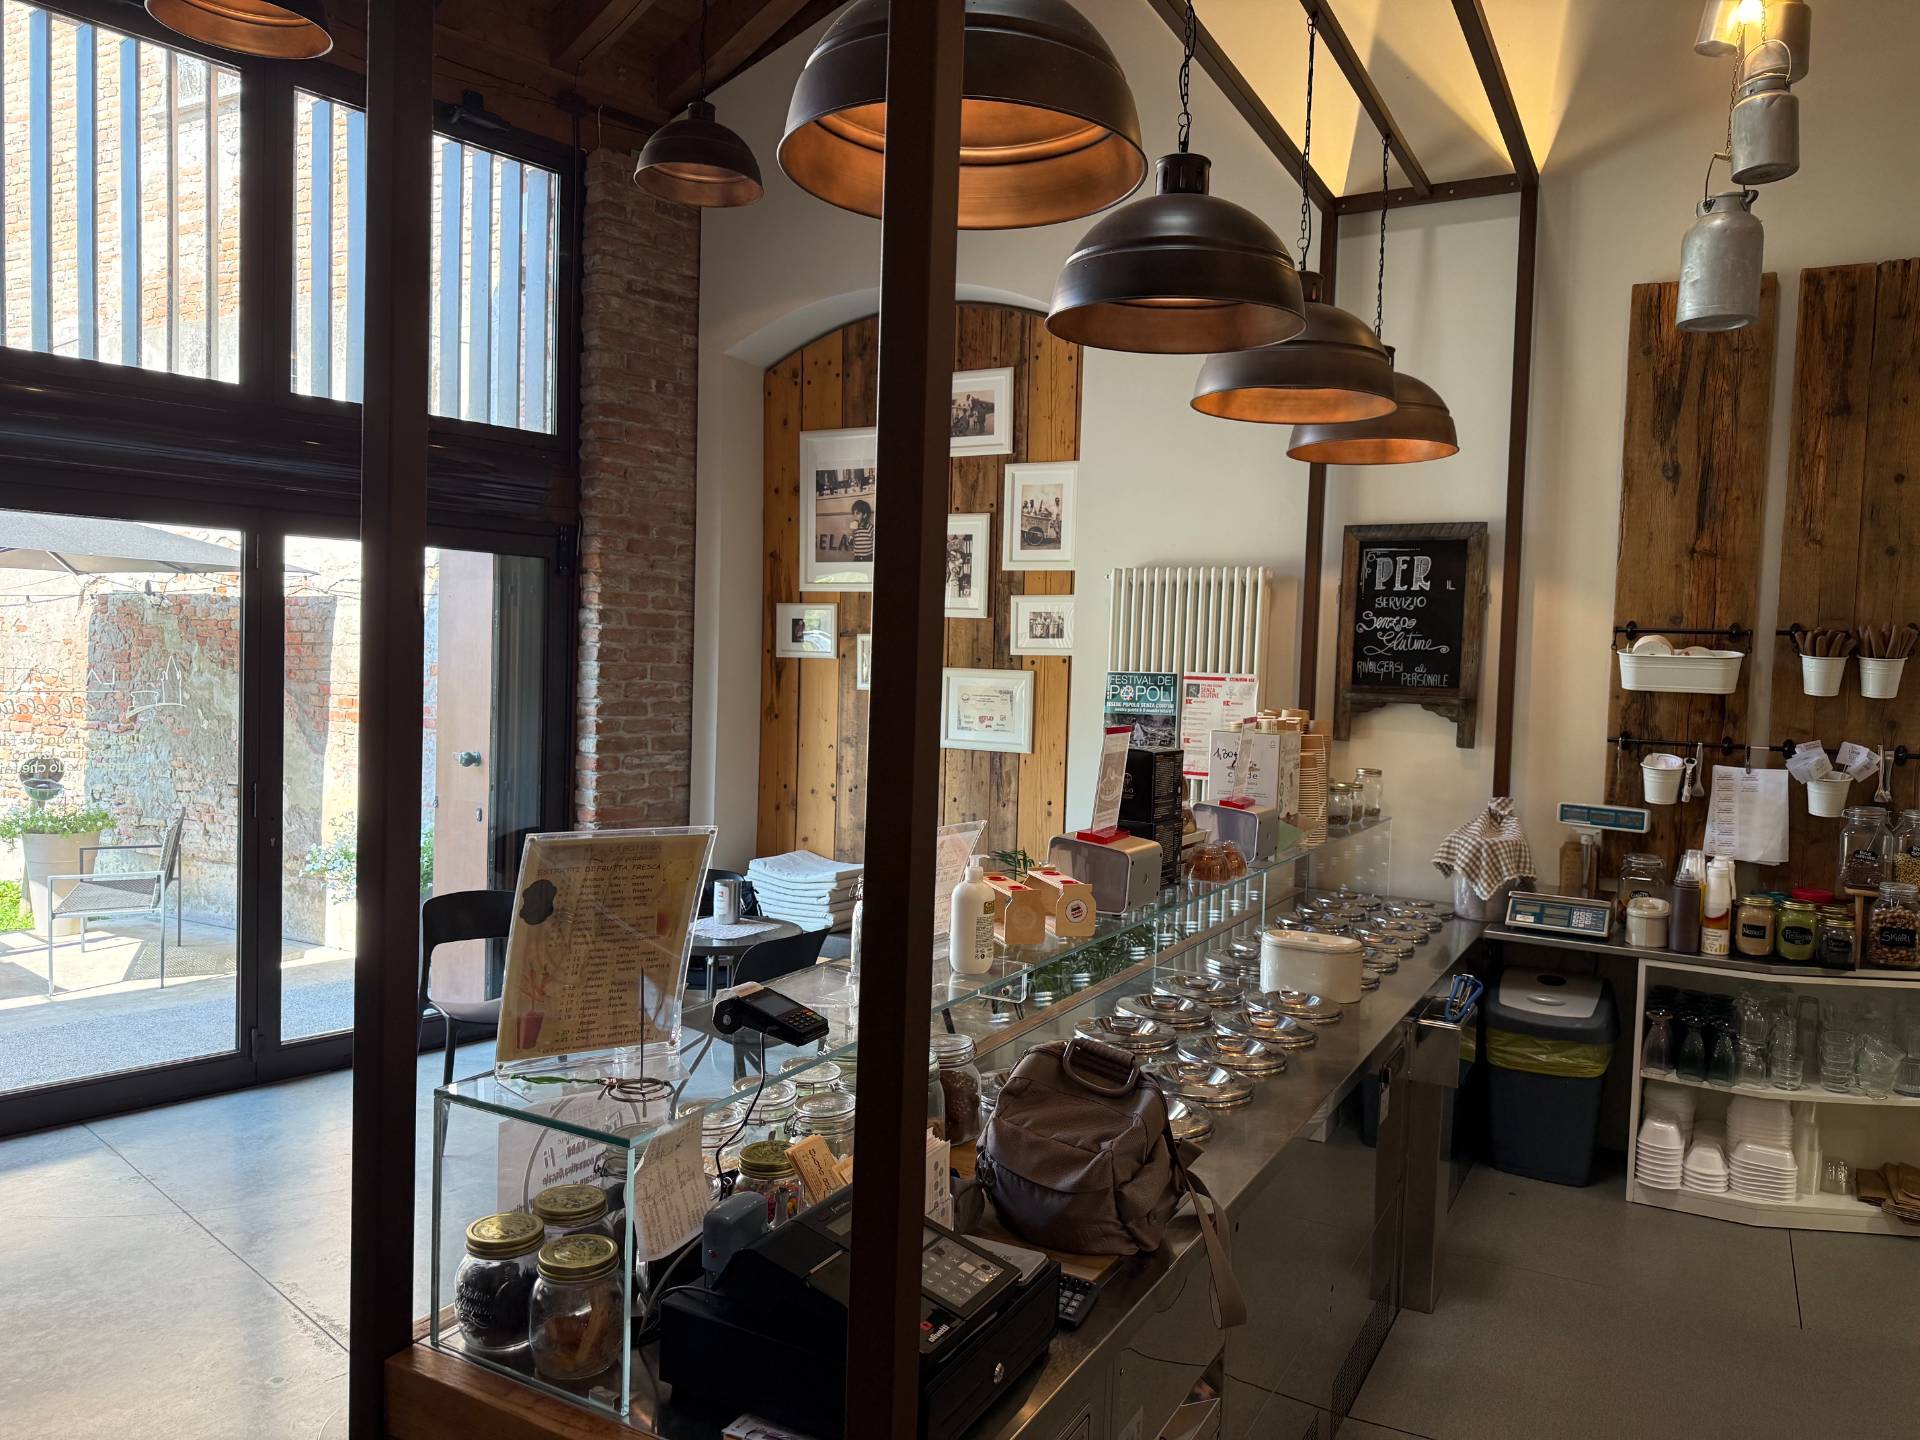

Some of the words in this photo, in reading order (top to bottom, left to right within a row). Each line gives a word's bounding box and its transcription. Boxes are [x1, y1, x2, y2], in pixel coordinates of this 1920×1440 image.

[816, 533, 849, 551] ELA
[1374, 555, 1432, 591] PER
[1446, 580, 1456, 590] IL
[1375, 596, 1427, 611] SERVIZIO
[1356, 610, 1417, 634] Senza
[1373, 631, 1450, 653] Glutine
[1356, 658, 1404, 681] RIVOLGERSI
[1109, 674, 1154, 686] FESTIVAL
[1157, 675, 1174, 687] DEI
[1401, 672, 1448, 688] PERSONALE
[1109, 684, 1174, 702] POPOLI
[928, 1323, 951, 1343] olivetti
